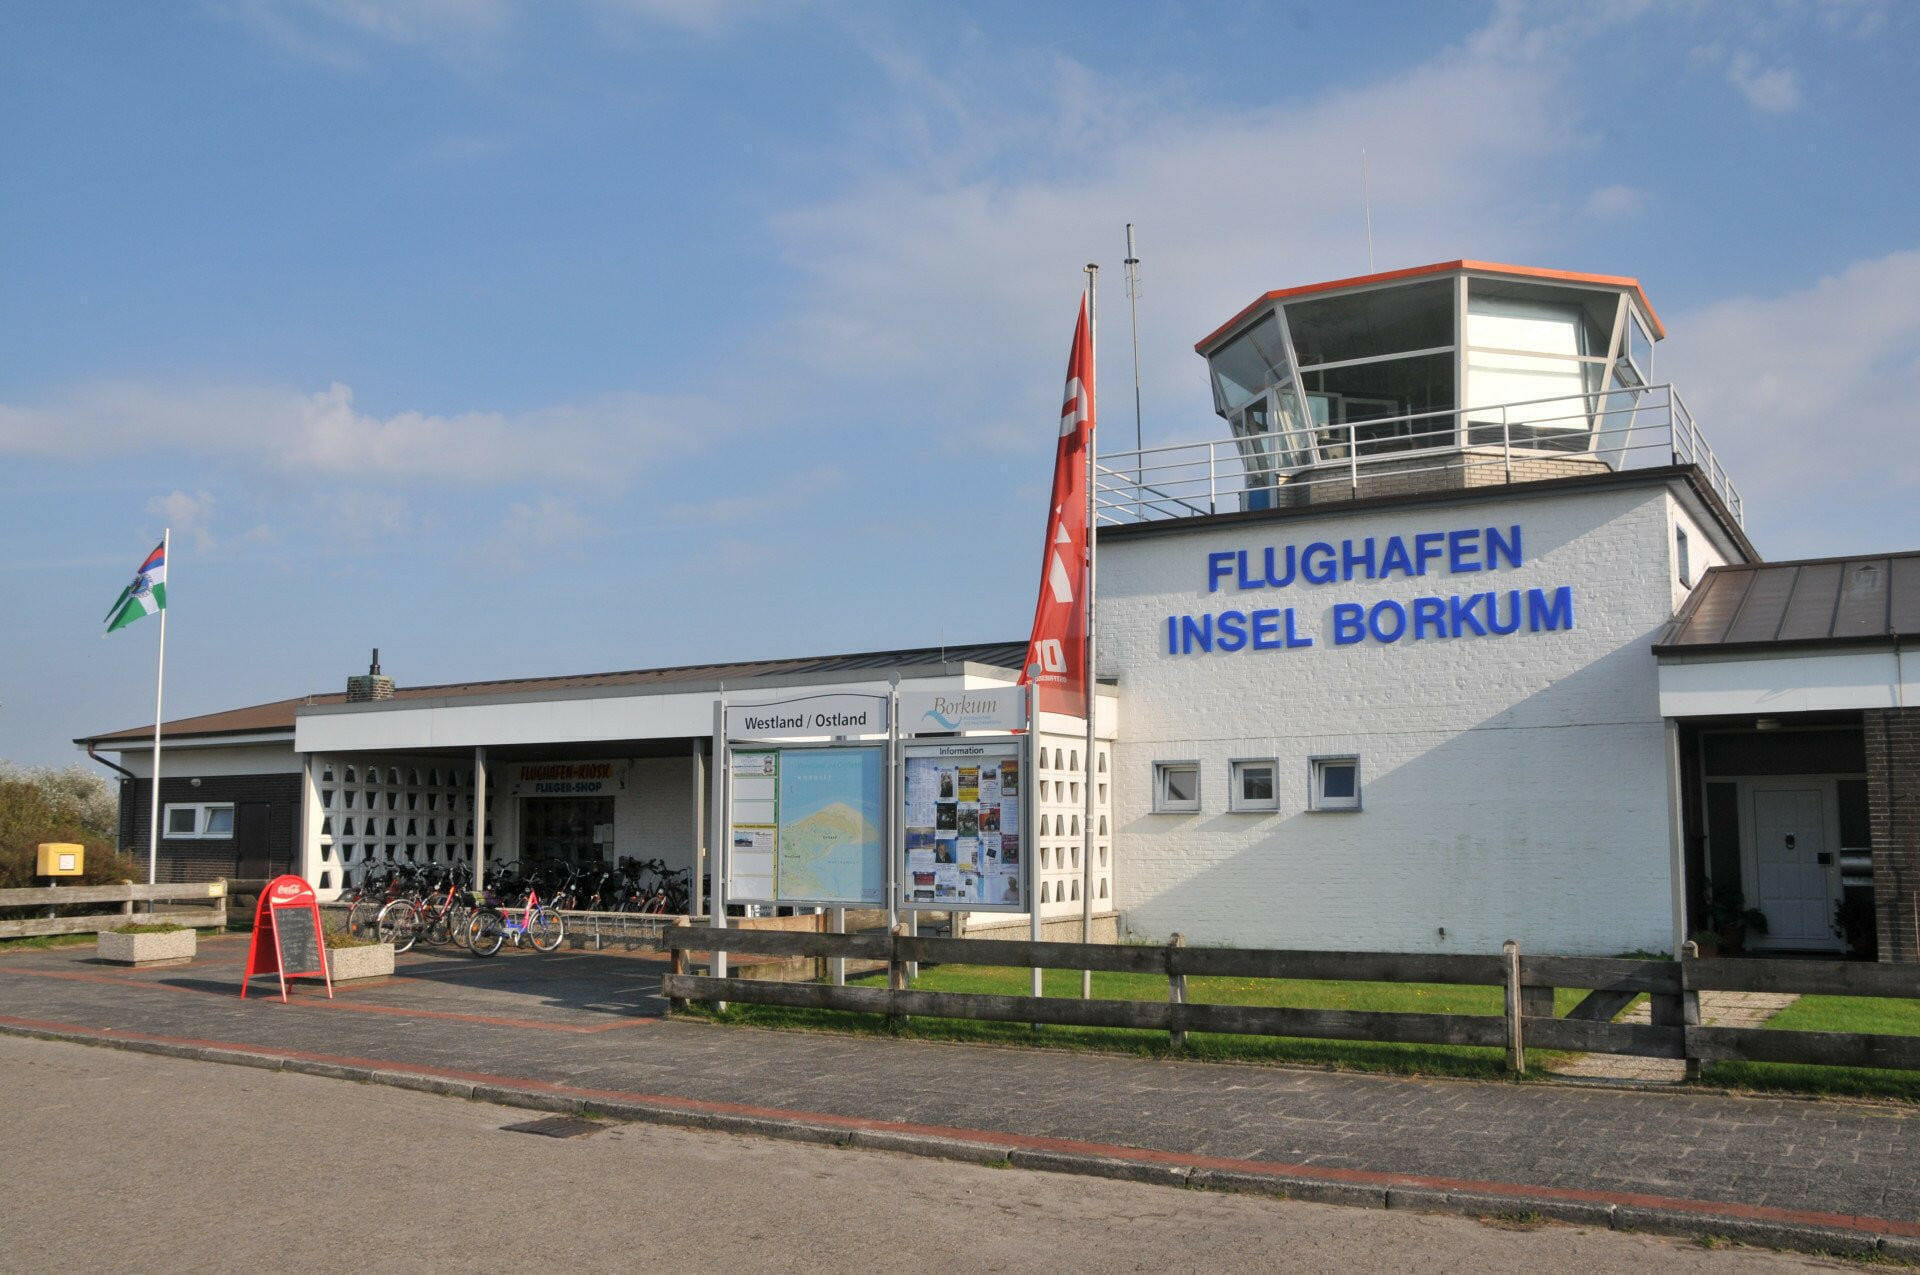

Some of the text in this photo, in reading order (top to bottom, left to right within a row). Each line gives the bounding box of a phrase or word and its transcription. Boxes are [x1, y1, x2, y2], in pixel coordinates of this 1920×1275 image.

[1208, 524, 1523, 592] FLUGHAFEN
[1168, 586, 1573, 655] INSEL BORKUM
[934, 694, 997, 715] Borkum
[744, 711, 867, 730] Westland / Ostland
[939, 747, 984, 755] Information
